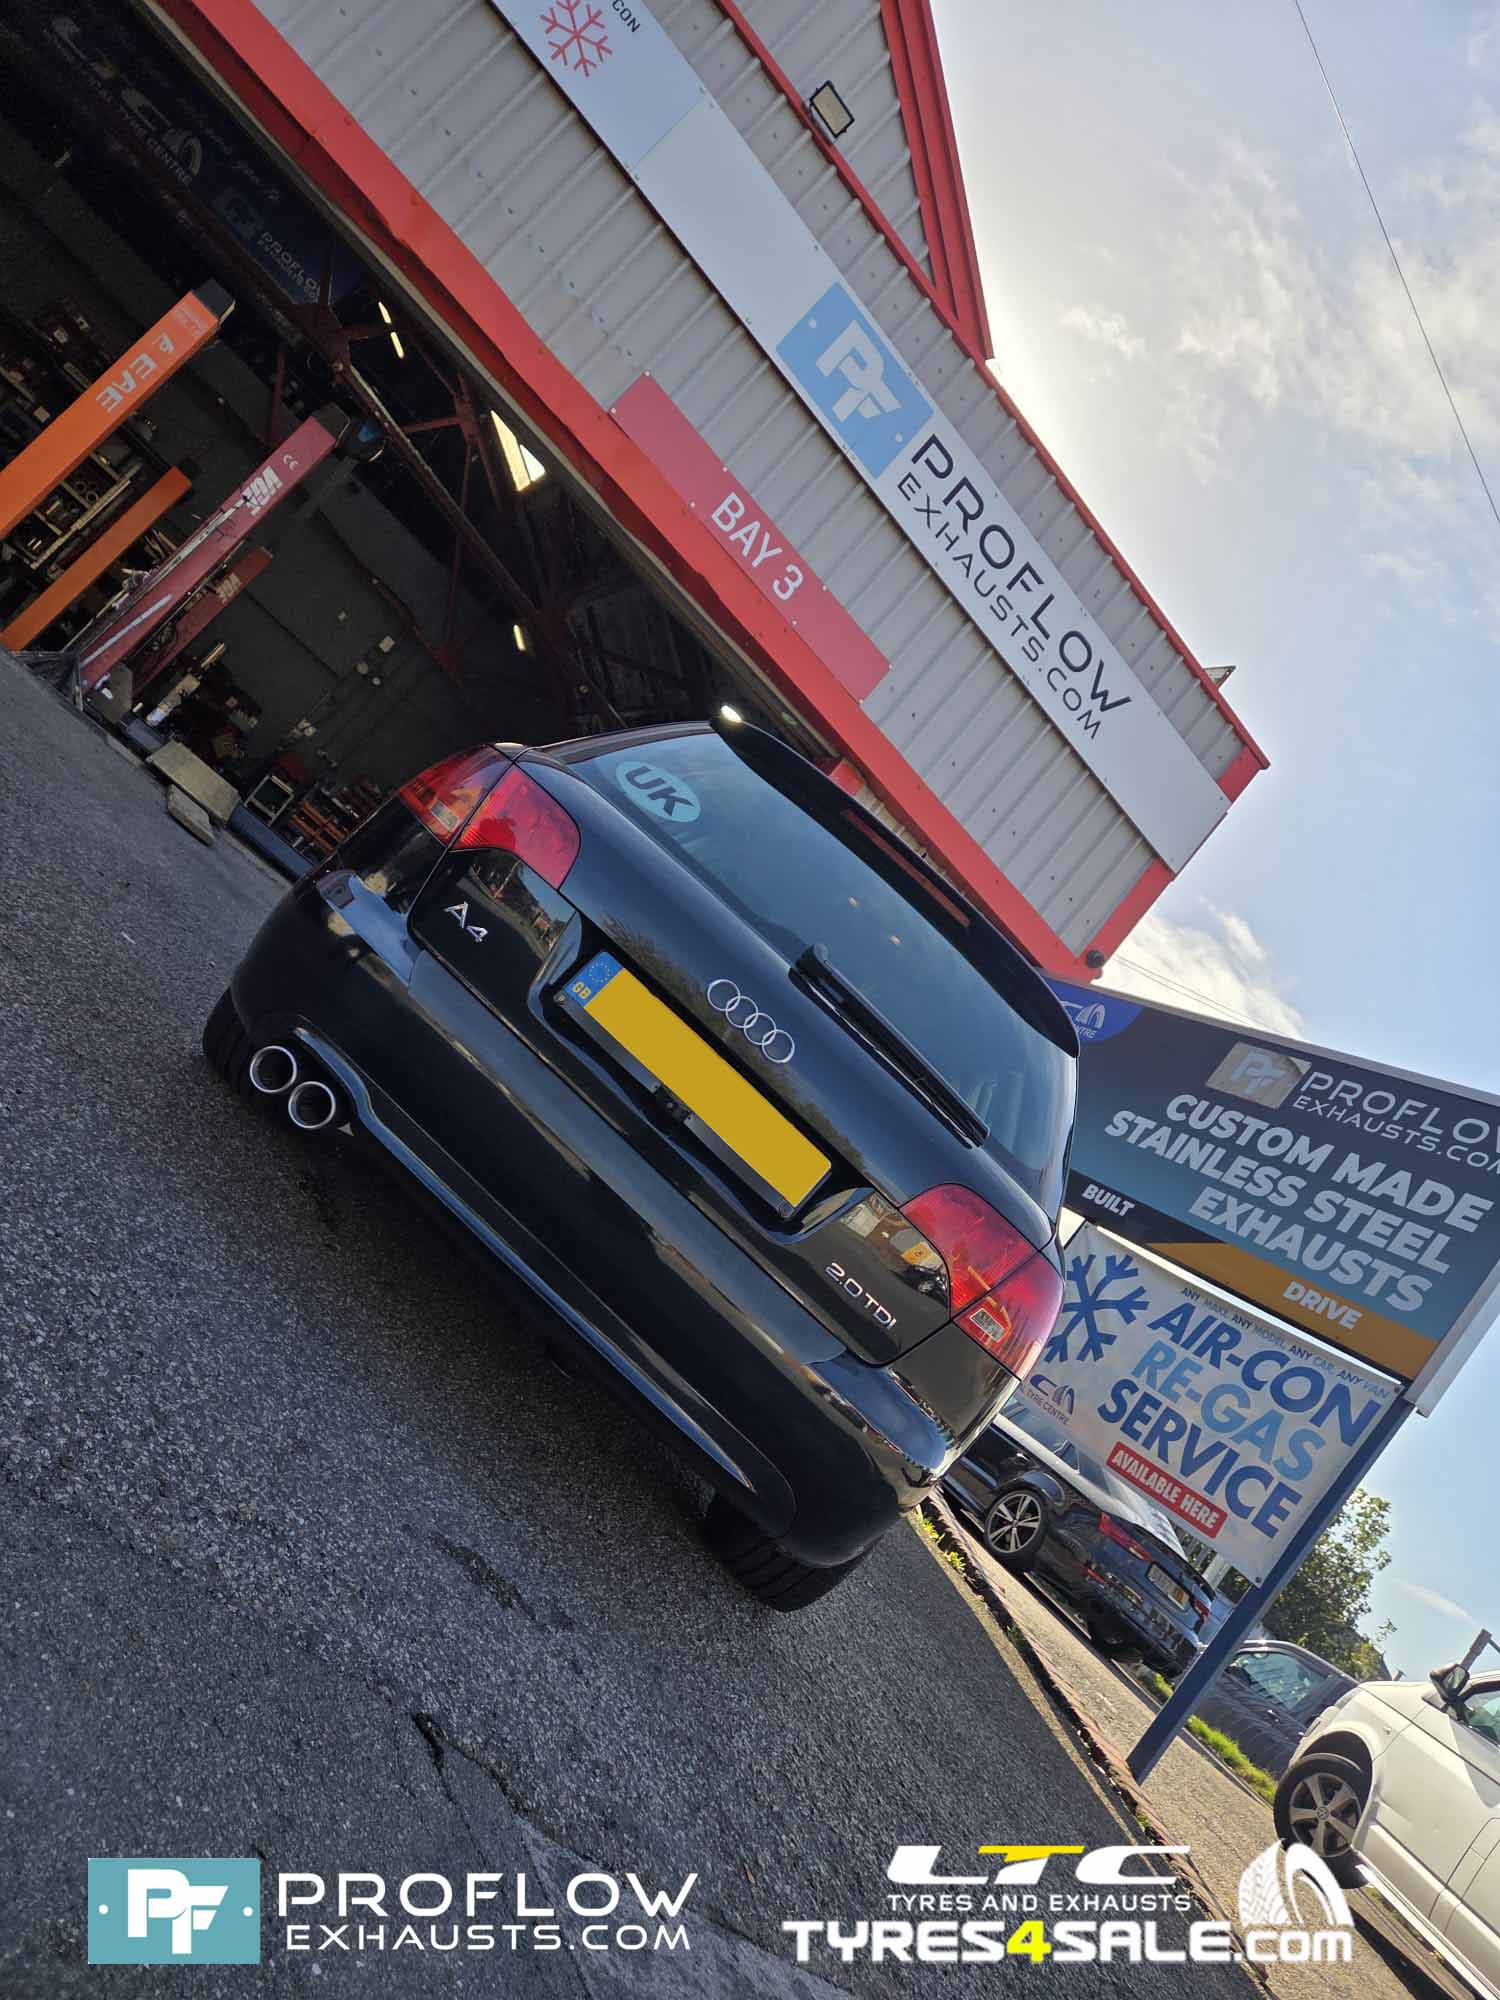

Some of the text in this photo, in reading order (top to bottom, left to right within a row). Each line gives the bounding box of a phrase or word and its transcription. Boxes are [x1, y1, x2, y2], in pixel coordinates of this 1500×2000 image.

[612, 0, 641, 33] CON
[261, 230, 321, 292] PROFLO
[711, 491, 804, 601] BAY 3
[911, 433, 1132, 712] PROFLOW
[897, 471, 1101, 740] EXHAUSTS.COM
[624, 765, 695, 817] UK
[443, 901, 489, 943] A4
[571, 981, 593, 1000] GB
[1300, 1070, 1500, 1154] PROFLO
[1081, 1183, 1136, 1217] BUILT
[1104, 1109, 1451, 1275] STAINLESS STEEL
[1165, 1093, 1494, 1233] CUSTOM MADE
[1187, 1185, 1433, 1312] EXHAUSTS
[1181, 1287, 1201, 1302] ANY
[1231, 1312, 1253, 1330] ANY
[1288, 1343, 1313, 1361] ANY
[1336, 1369, 1363, 1386] ANY
[1282, 1280, 1363, 1330] DRIVE
[1131, 1339, 1327, 1482] RE-GAS
[1147, 1302, 1382, 1447] AIR-CON
[1097, 1378, 1303, 1539] SERVICE
[1111, 1449, 1221, 1530] AVAILABLE HERE
